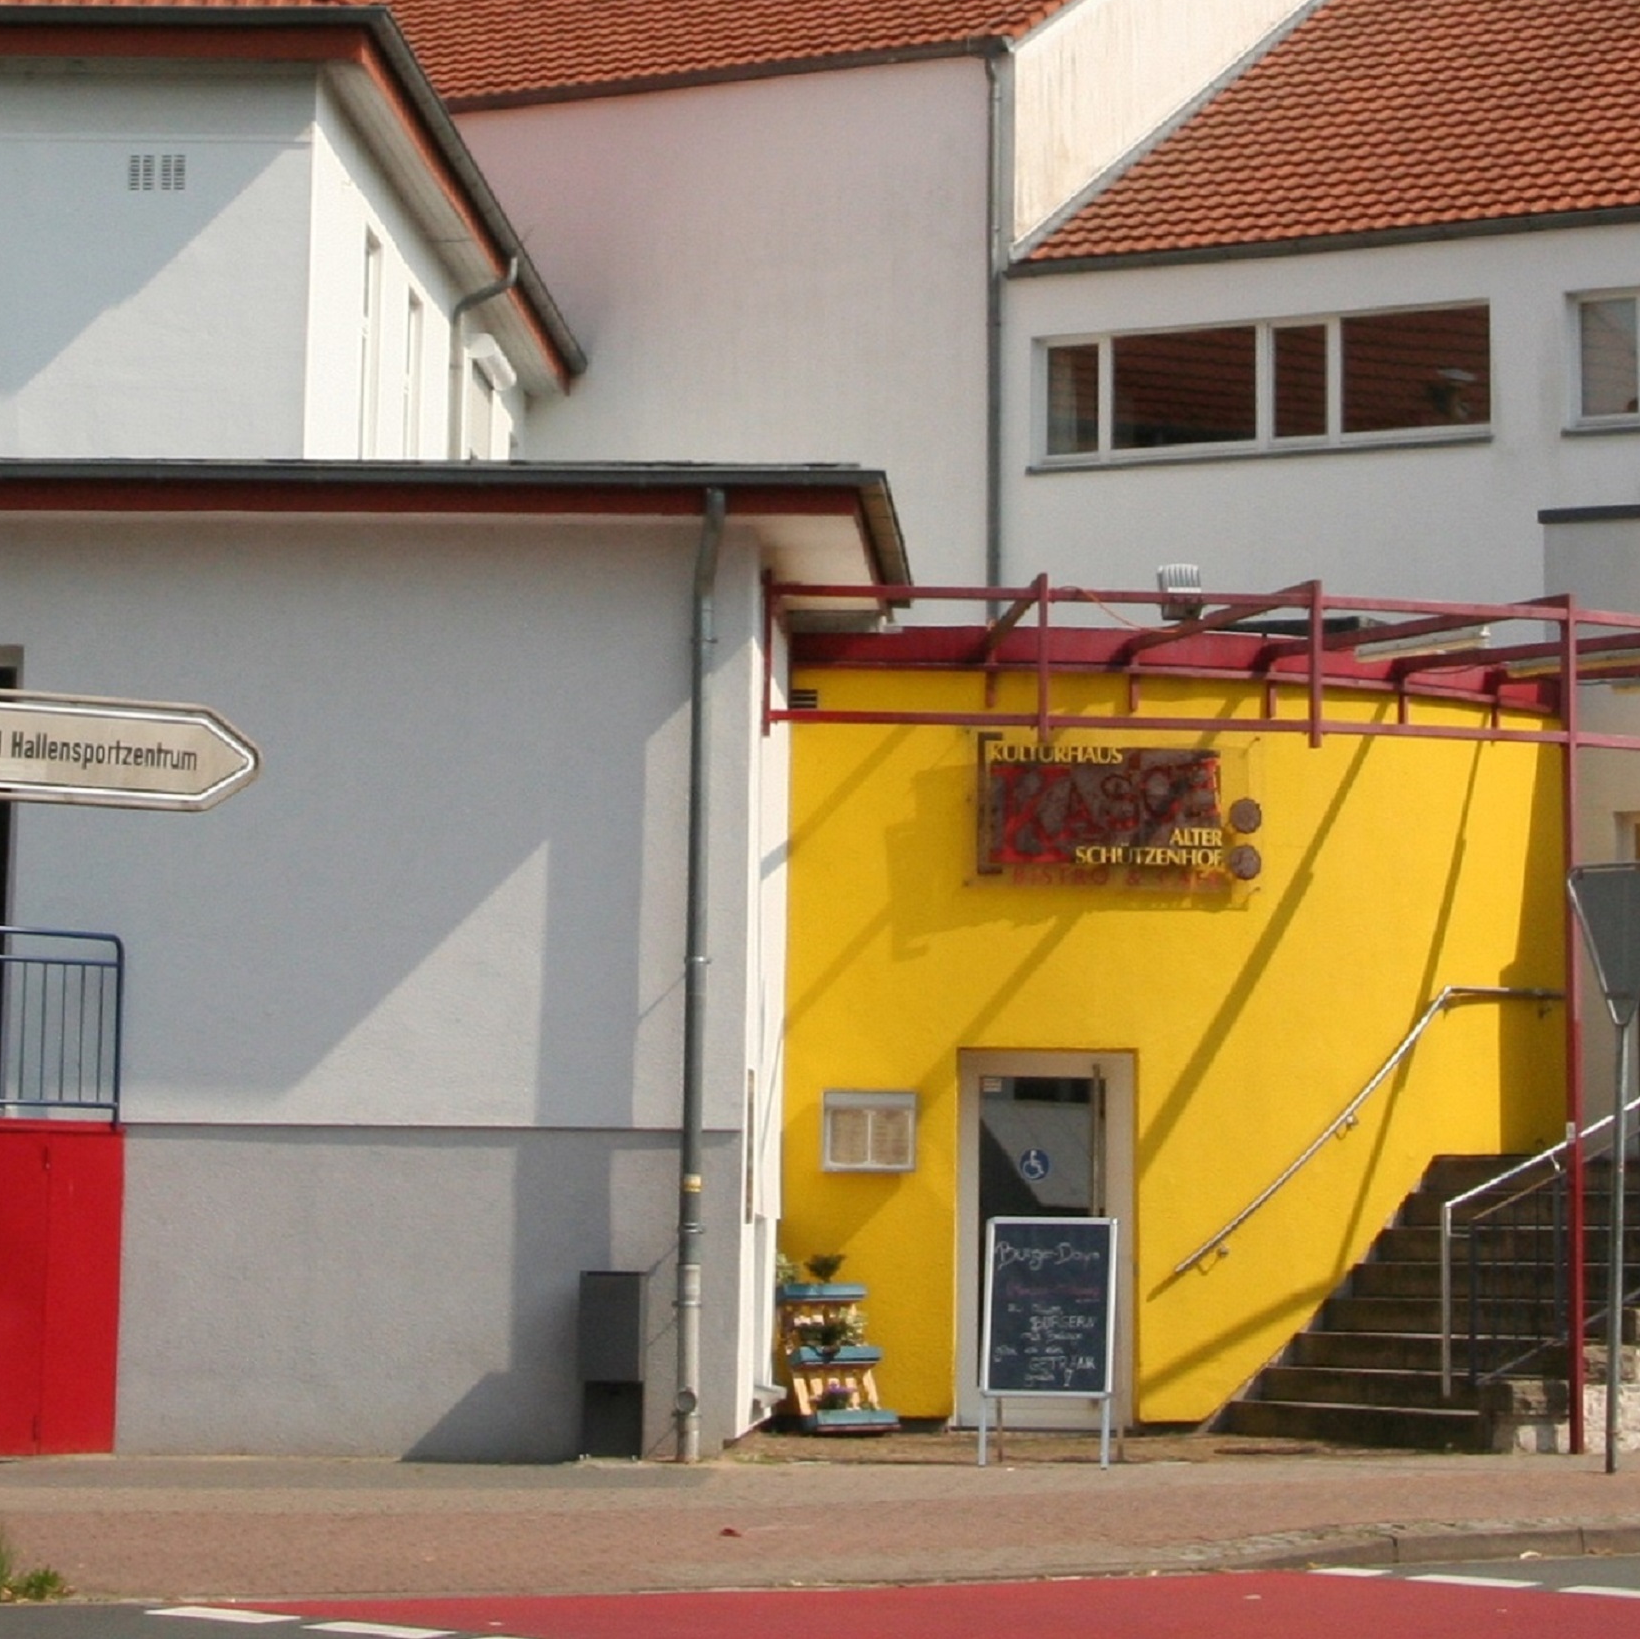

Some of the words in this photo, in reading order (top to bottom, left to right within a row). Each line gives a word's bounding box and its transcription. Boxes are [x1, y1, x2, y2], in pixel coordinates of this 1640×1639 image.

[11, 730, 197, 770] Hallensportzentrum
[989, 744, 1124, 764] KULTURHAUS
[1169, 827, 1222, 847] ALTER
[1075, 842, 1222, 866] SCHÜTZENHOF
